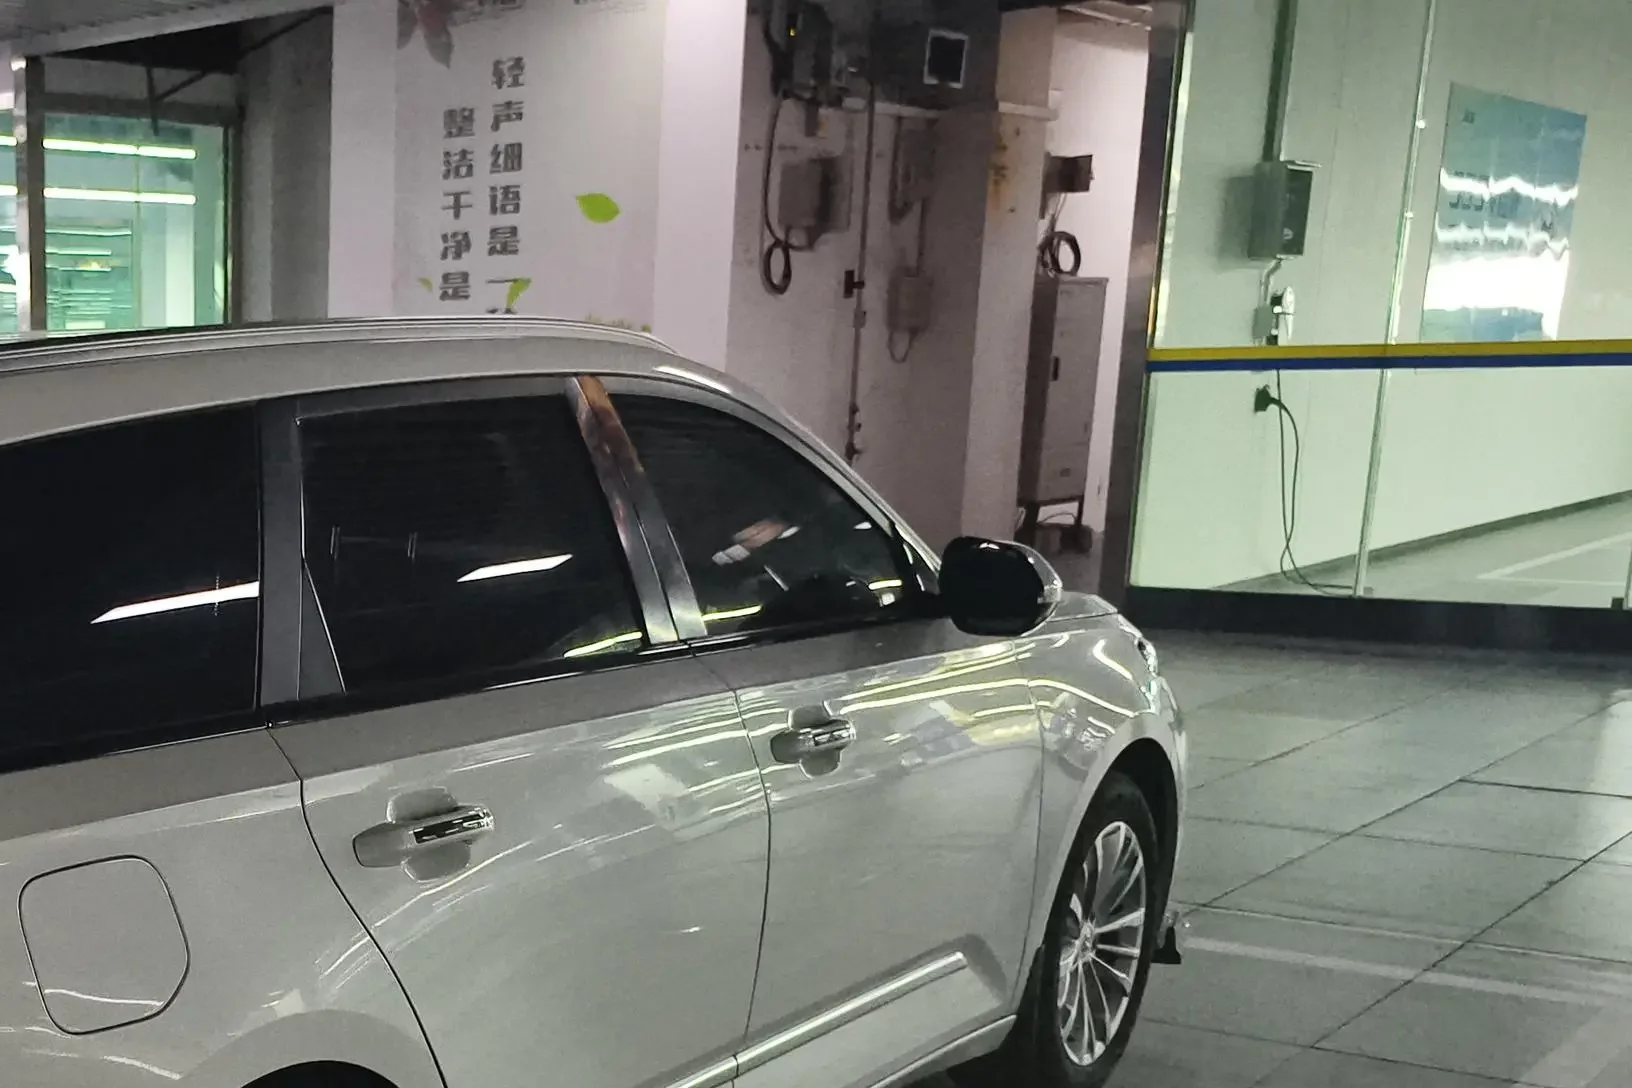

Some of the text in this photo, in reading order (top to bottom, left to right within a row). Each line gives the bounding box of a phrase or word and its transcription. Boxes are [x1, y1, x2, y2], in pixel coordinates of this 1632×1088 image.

[439, 107, 475, 301] 整洁干净是
[485, 56, 527, 315] 轻声细语是一
